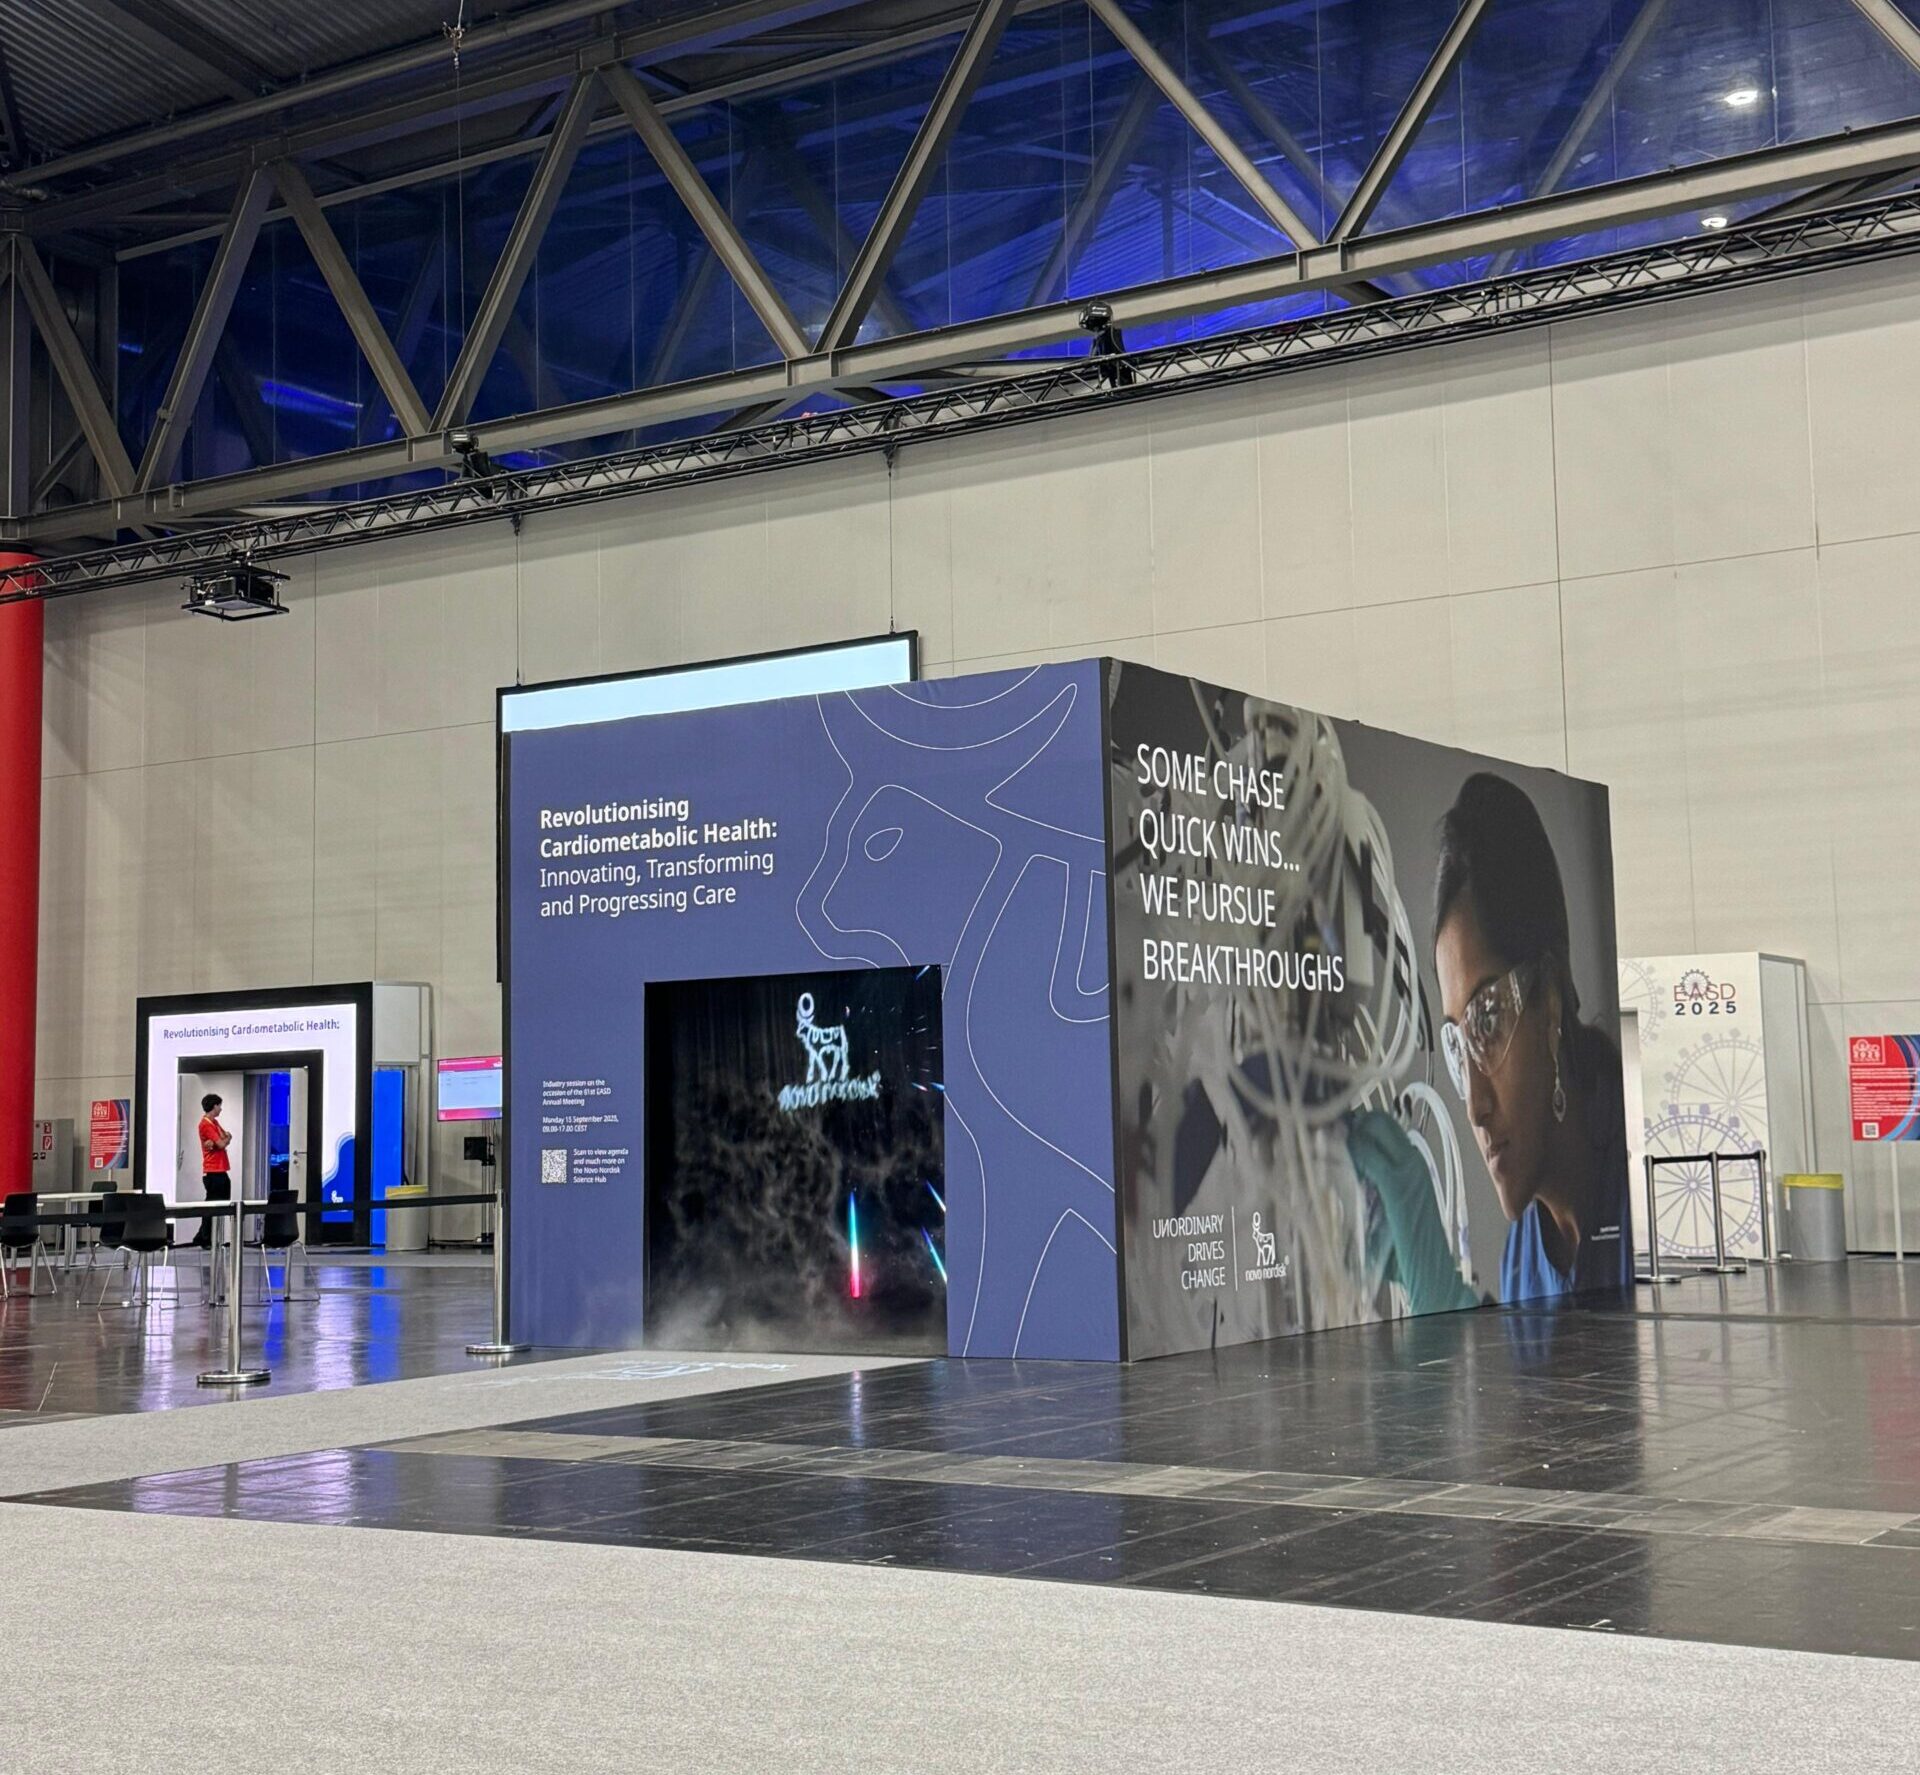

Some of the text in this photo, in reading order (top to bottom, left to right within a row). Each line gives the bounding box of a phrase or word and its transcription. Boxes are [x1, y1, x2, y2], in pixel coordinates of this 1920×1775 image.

[1137, 743, 1285, 811] SOME CHASE
[540, 797, 690, 830] Revolutionising
[540, 817, 778, 859] Cardiometabolic Health:
[1139, 808, 1300, 873] QUICK WINS...
[539, 850, 775, 888] Innovating, Transforming
[540, 885, 737, 919] and Progressing Care
[1139, 872, 1277, 928] WE PURSUE
[1143, 938, 1345, 993] BREAKTHROUGHS
[1673, 982, 1736, 1001] EASD
[1674, 1001, 1737, 1016] 2025
[163, 1018, 340, 1039] Revolutionising Cardiometabolic Health:
[542, 1080, 565, 1089] Industry
[566, 1088, 574, 1096] of
[573, 1088, 583, 1096] the
[596, 1087, 612, 1095] EASD
[562, 1098, 585, 1107] Meeting
[573, 1115, 603, 1124] September
[573, 1148, 587, 1156] Scan
[607, 1148, 629, 1156] agenda
[585, 1157, 601, 1165] much
[573, 1175, 607, 1184] Science Hub
[583, 1166, 599, 1174] Novo
[598, 1166, 620, 1174] Nordisk
[1188, 1240, 1226, 1263] DRIVES
[1181, 1266, 1226, 1290] CHANGE
[1245, 1264, 1287, 1282] novo nordisk
